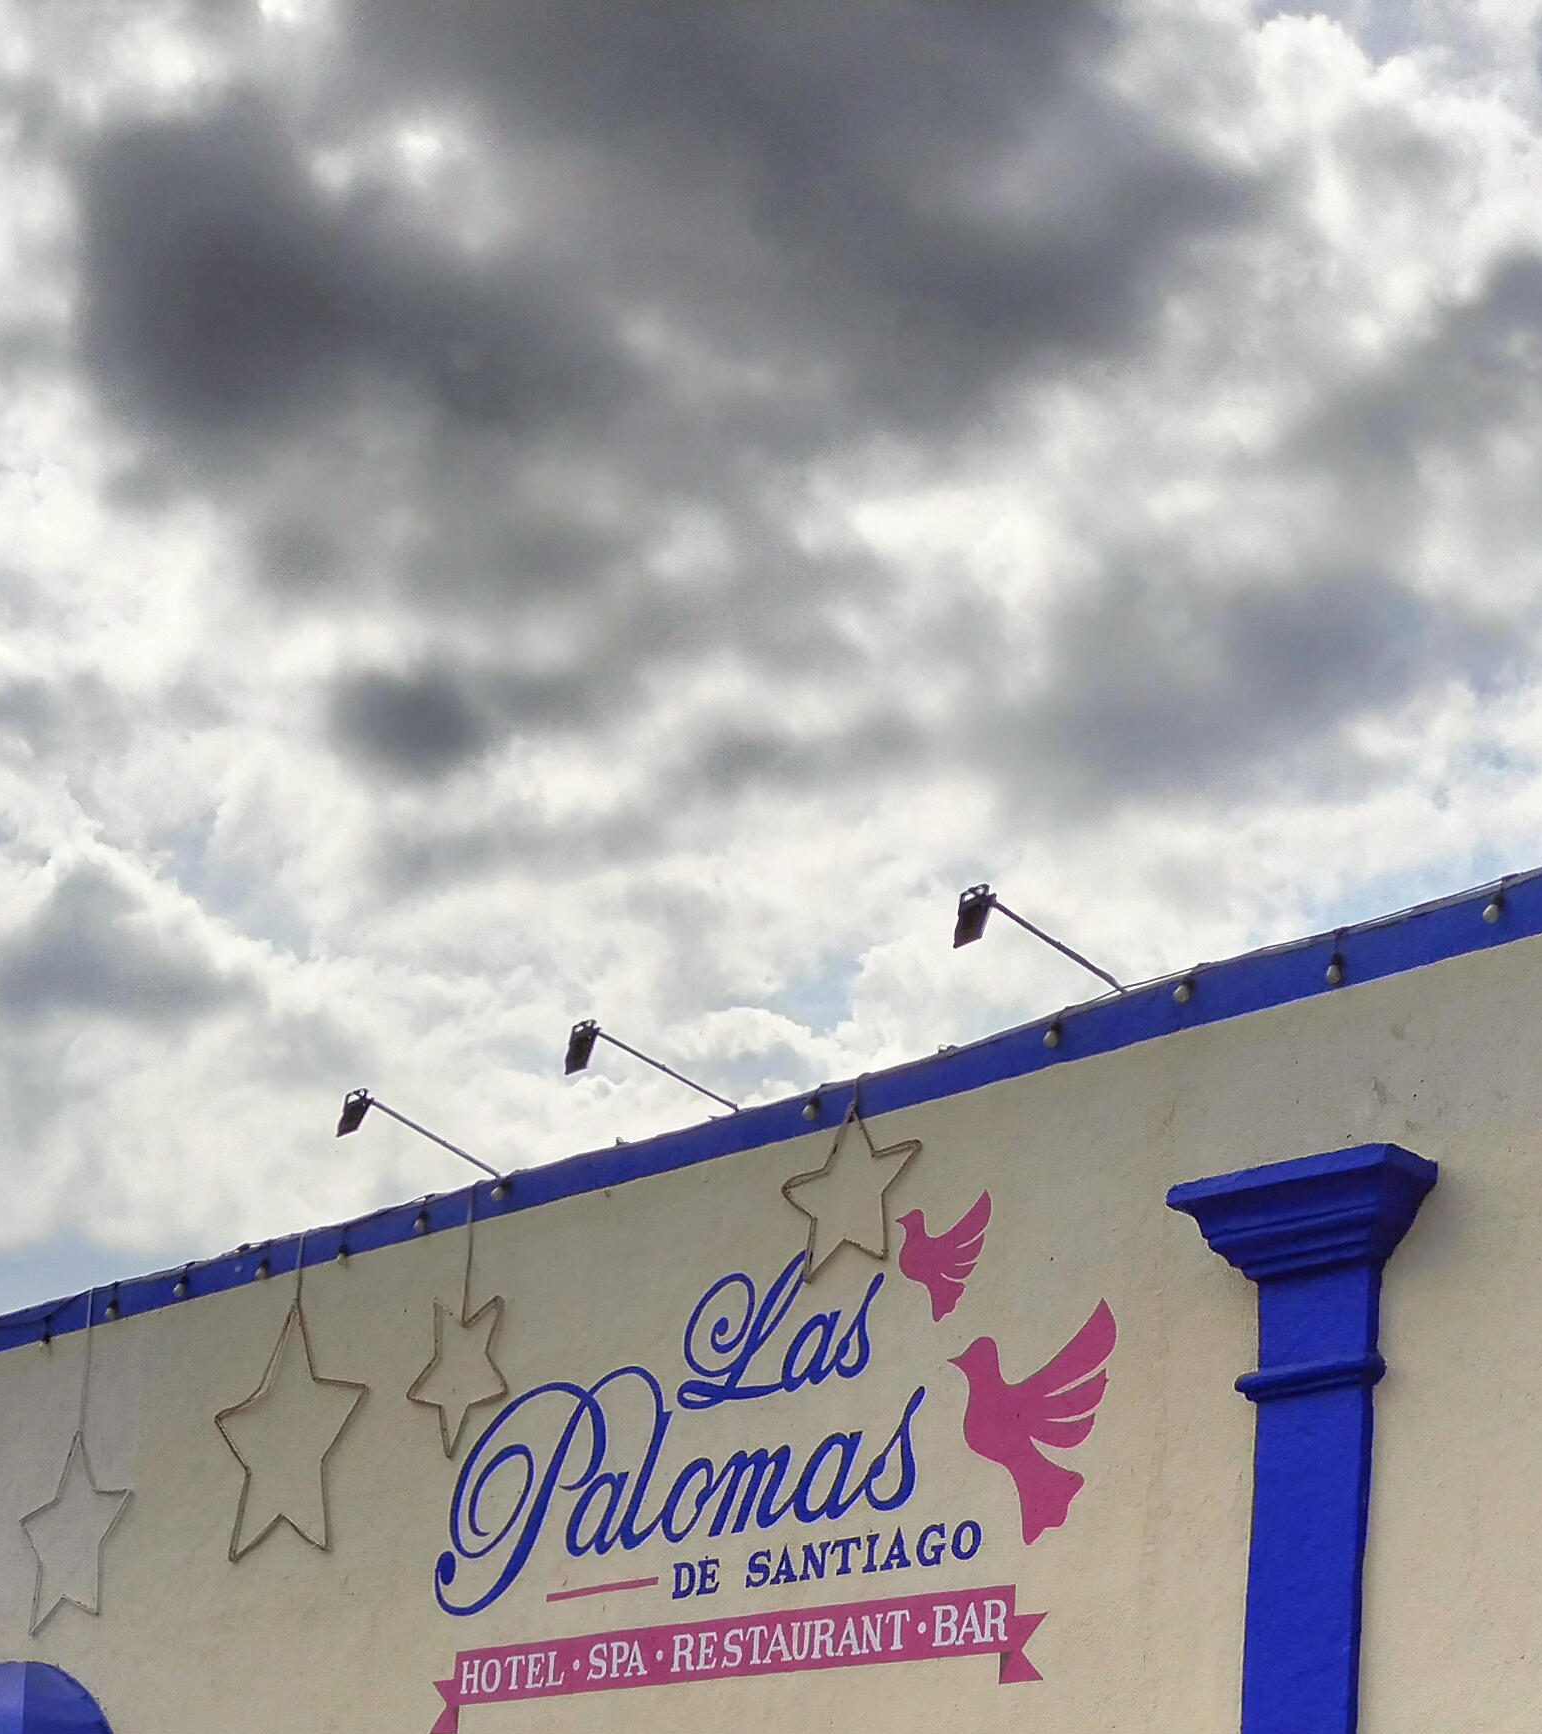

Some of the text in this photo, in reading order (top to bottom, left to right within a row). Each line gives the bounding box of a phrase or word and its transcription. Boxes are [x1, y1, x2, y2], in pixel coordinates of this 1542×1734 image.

[676, 1250, 886, 1411] Las
[434, 1365, 927, 1617] Palomas
[671, 1519, 983, 1600] DE SANTIAGO
[459, 1598, 1008, 1696] HOTEL SPA RESTAURANT BAR
